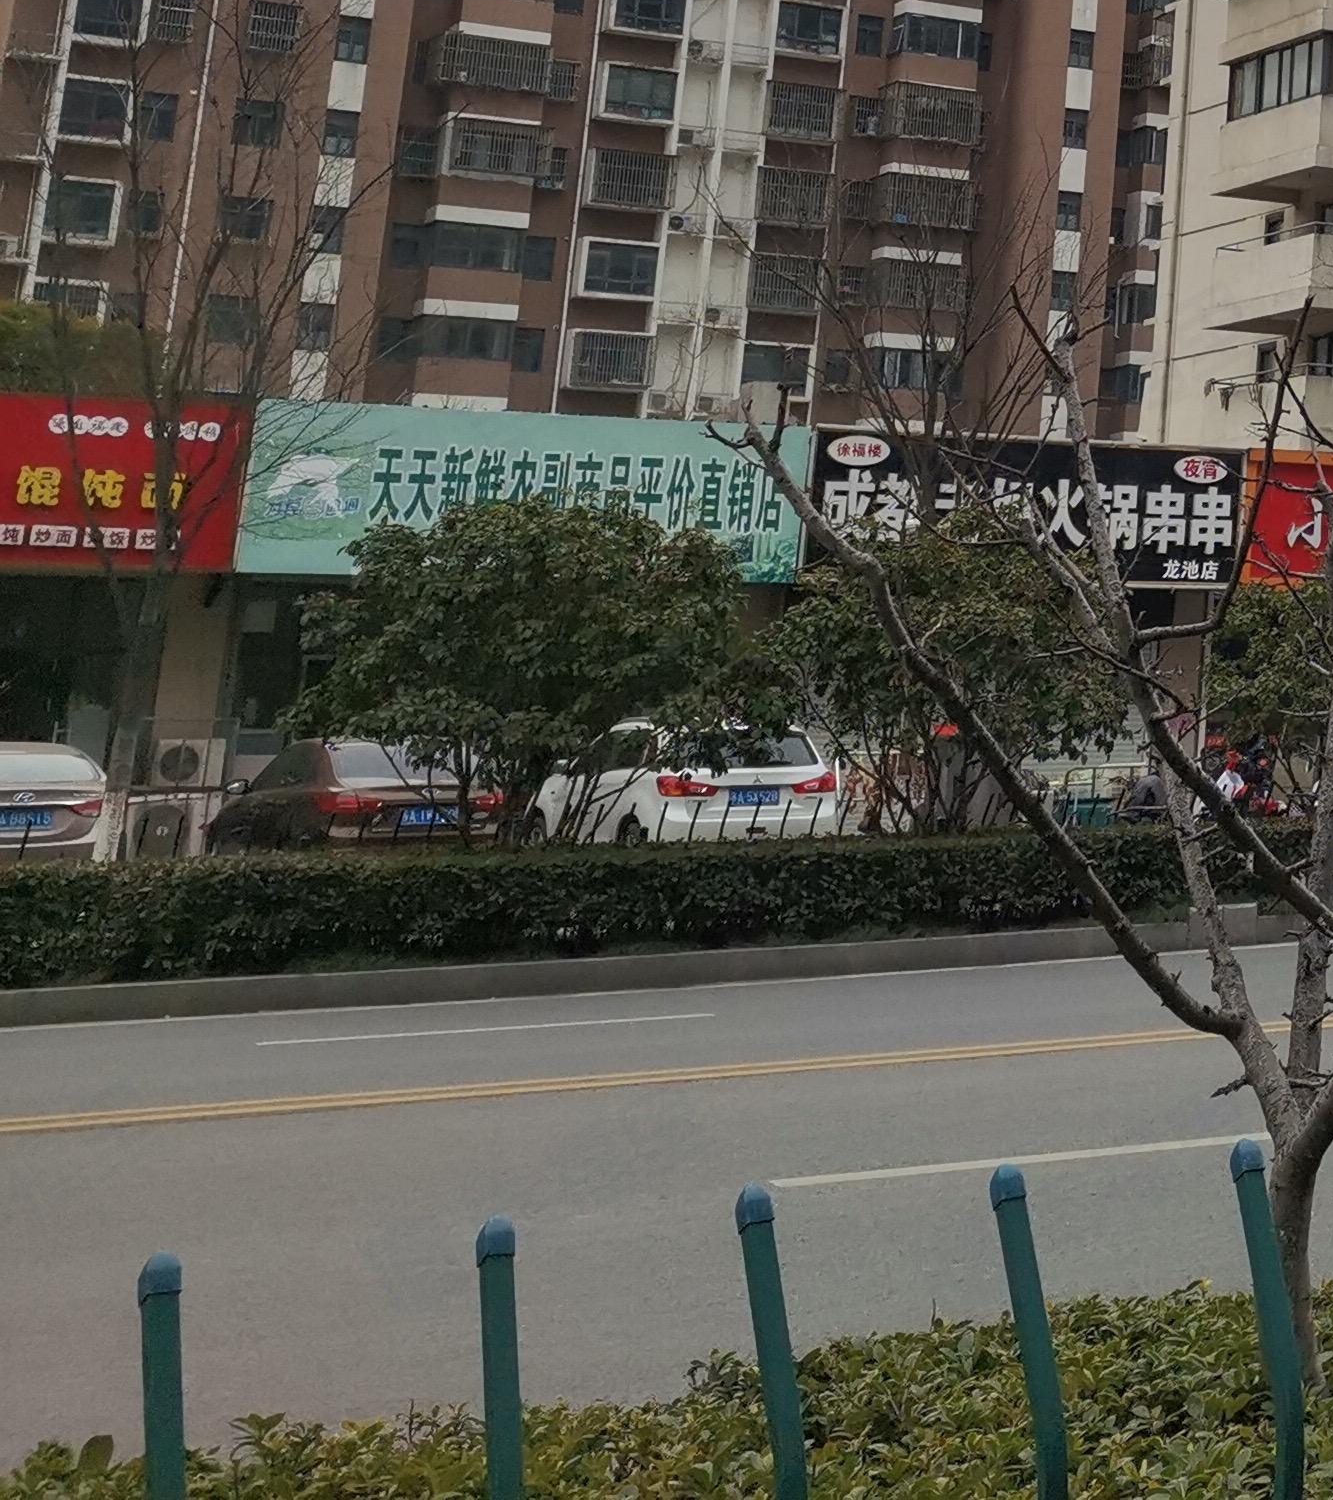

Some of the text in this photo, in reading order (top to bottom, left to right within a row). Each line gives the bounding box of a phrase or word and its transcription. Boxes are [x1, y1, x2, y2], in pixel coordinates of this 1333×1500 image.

[368, 446, 784, 532] 天天新鲜农副产品平价直销店
[1182, 457, 1219, 480] 夜宵
[822, 469, 1233, 555] 成都火锅串串
[1162, 558, 1218, 581] 龙池店
